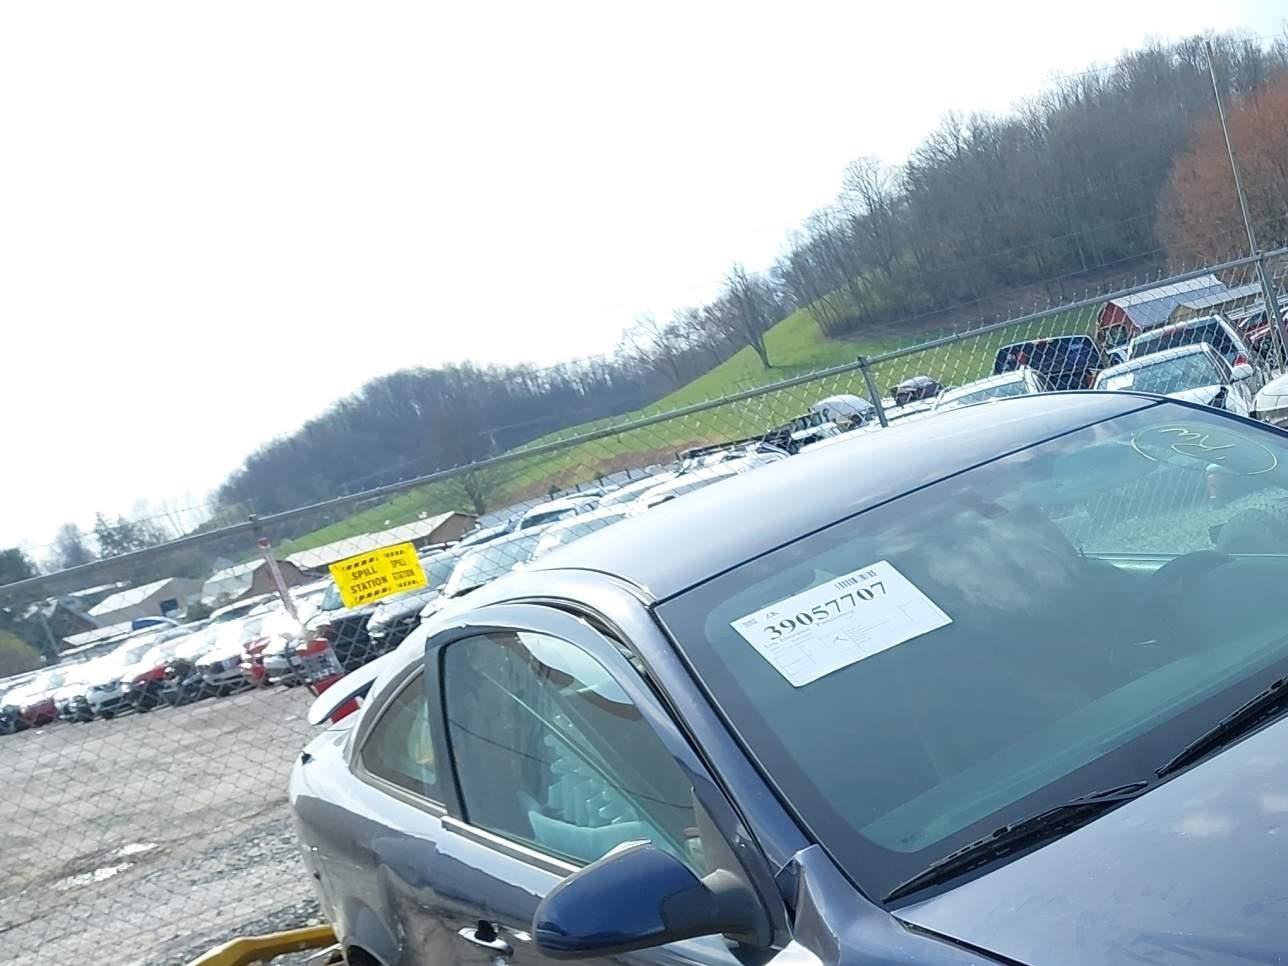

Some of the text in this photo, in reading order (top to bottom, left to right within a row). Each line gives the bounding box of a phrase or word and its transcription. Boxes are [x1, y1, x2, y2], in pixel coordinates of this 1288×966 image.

[352, 566, 378, 581] SPILL
[350, 576, 388, 594] STATION
[763, 580, 887, 640] 39057707
